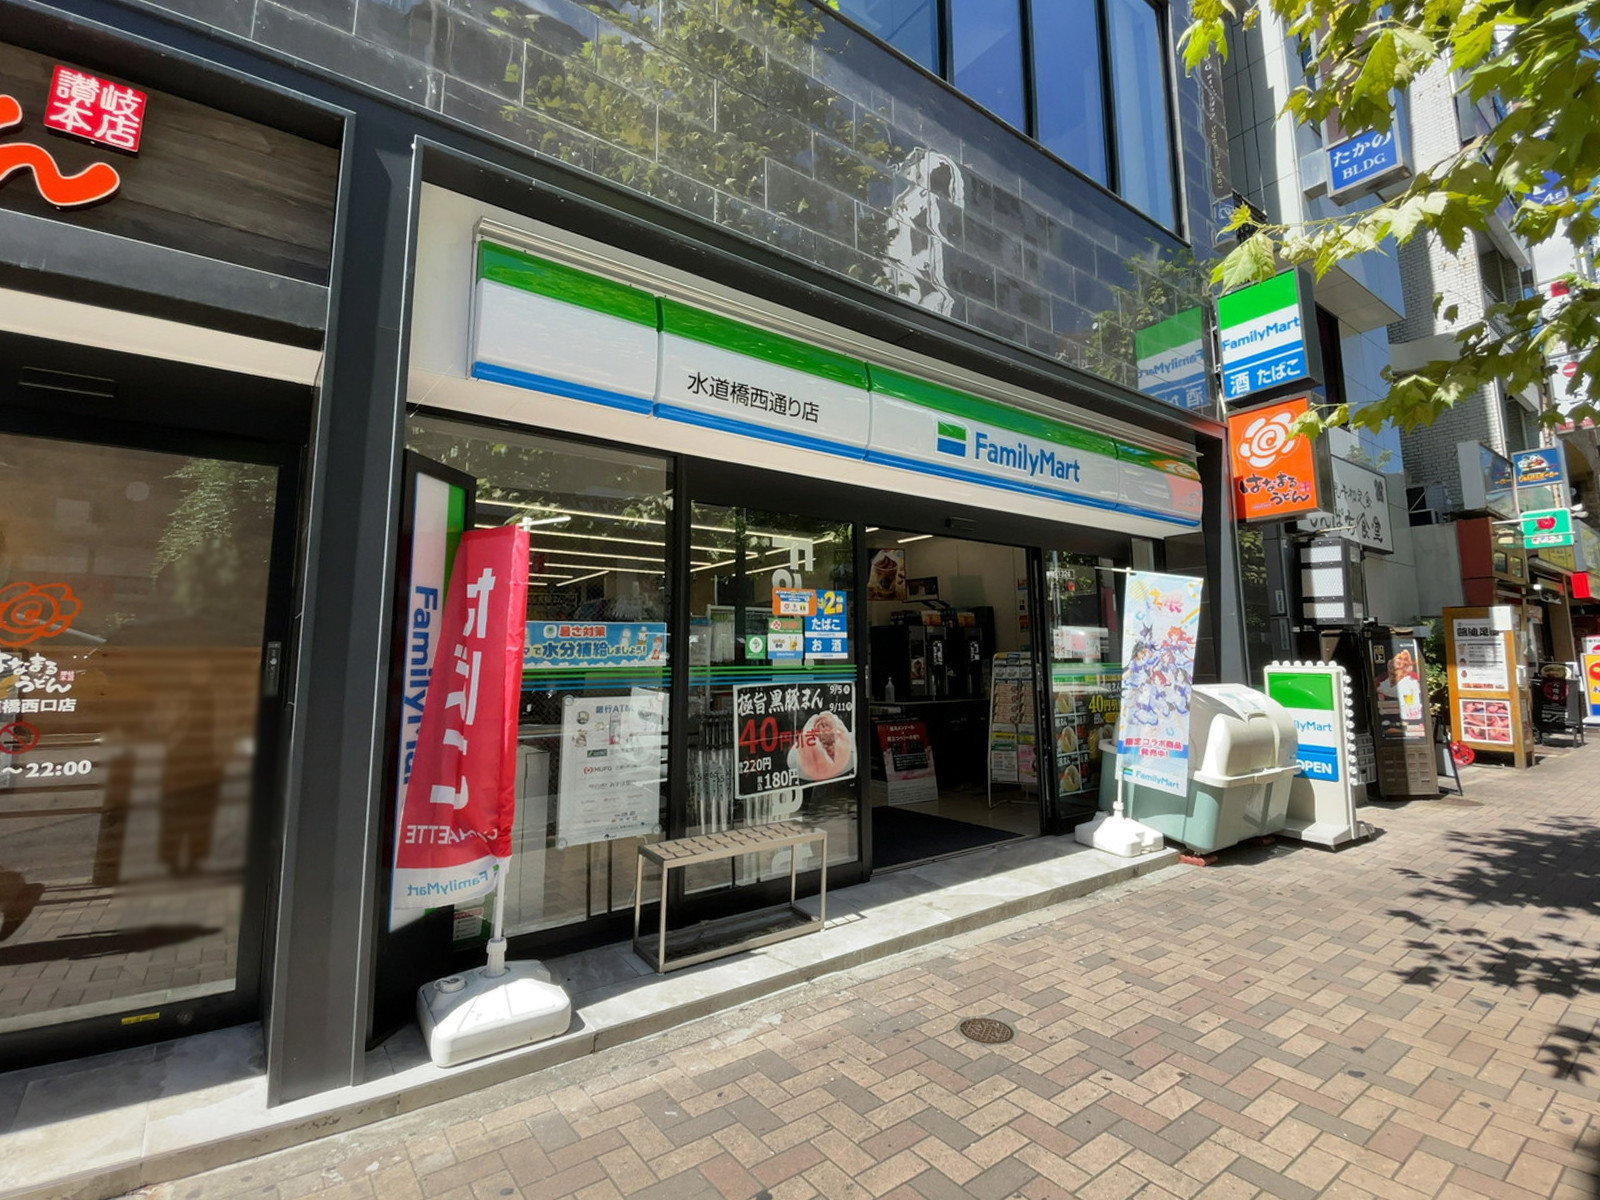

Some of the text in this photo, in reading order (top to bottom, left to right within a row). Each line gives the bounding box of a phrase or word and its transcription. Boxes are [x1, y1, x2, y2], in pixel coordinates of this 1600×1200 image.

[49, 98, 139, 149] 本店
[1333, 131, 1391, 168] たかの
[1342, 153, 1386, 180] BLDG
[1222, 316, 1300, 351] FamilyMart
[1230, 358, 1301, 394] 酒 たばこ
[687, 371, 820, 423] 水道橋西通り店
[974, 431, 1080, 483] FamilyMart
[1240, 472, 1297, 493] はなまる
[1270, 489, 1310, 505] うどん
[559, 625, 606, 638] 暑さ対策
[811, 617, 841, 631] たばこ
[15, 675, 72, 693] うどん
[0, 698, 78, 713] 橋西口店
[737, 687, 824, 717] 極旨黒豚まん
[1125, 737, 1182, 750] 限定コラボ商品
[1141, 748, 1168, 756] 発売中!
[1297, 759, 1332, 775] OPEN
[764, 768, 800, 790] 180円
[1136, 771, 1180, 789] FamilyMart
